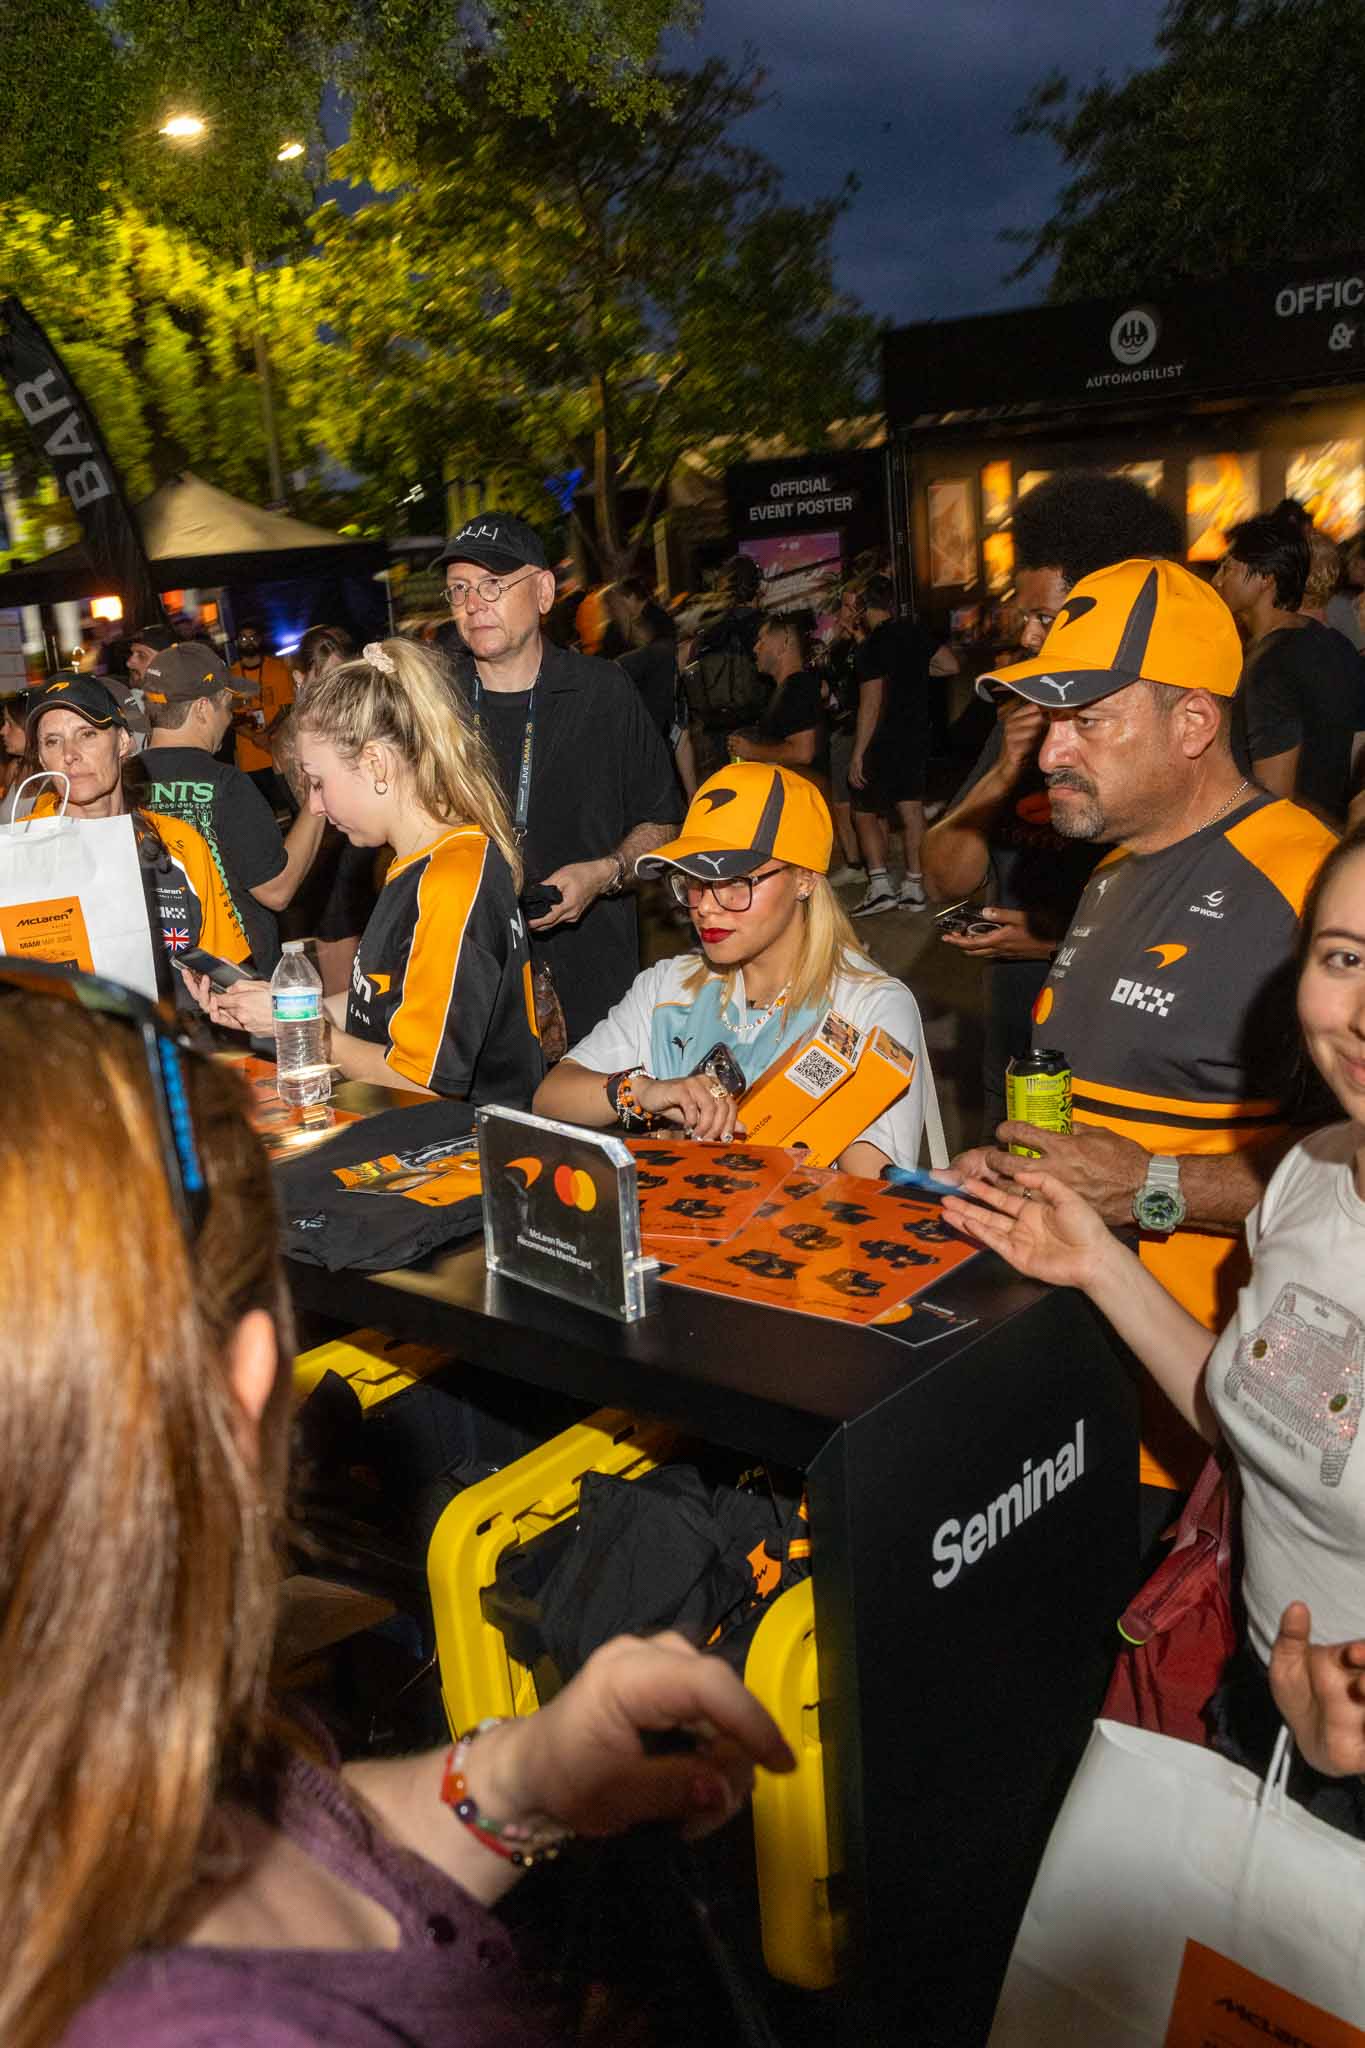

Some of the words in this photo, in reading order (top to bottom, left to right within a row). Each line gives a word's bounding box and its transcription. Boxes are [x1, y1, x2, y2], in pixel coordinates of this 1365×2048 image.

[1275, 277, 1365, 317] OFFIC
[1328, 322, 1355, 350] &
[1086, 364, 1184, 388] AUTOMOBILIST
[14, 369, 111, 510] BAR
[770, 478, 831, 498] OFFICIAL
[749, 504, 794, 521] EVENT
[797, 496, 853, 515] POSTER
[16, 908, 73, 928] McLaren
[1200, 907, 1224, 919] WORLD
[1110, 978, 1175, 1017] OKX
[517, 1235, 556, 1257] Recommends
[556, 1249, 592, 1271] Mastercard
[529, 1228, 556, 1244] McLaren
[555, 1238, 577, 1255] Racing
[932, 1418, 1085, 1589] Seminal
